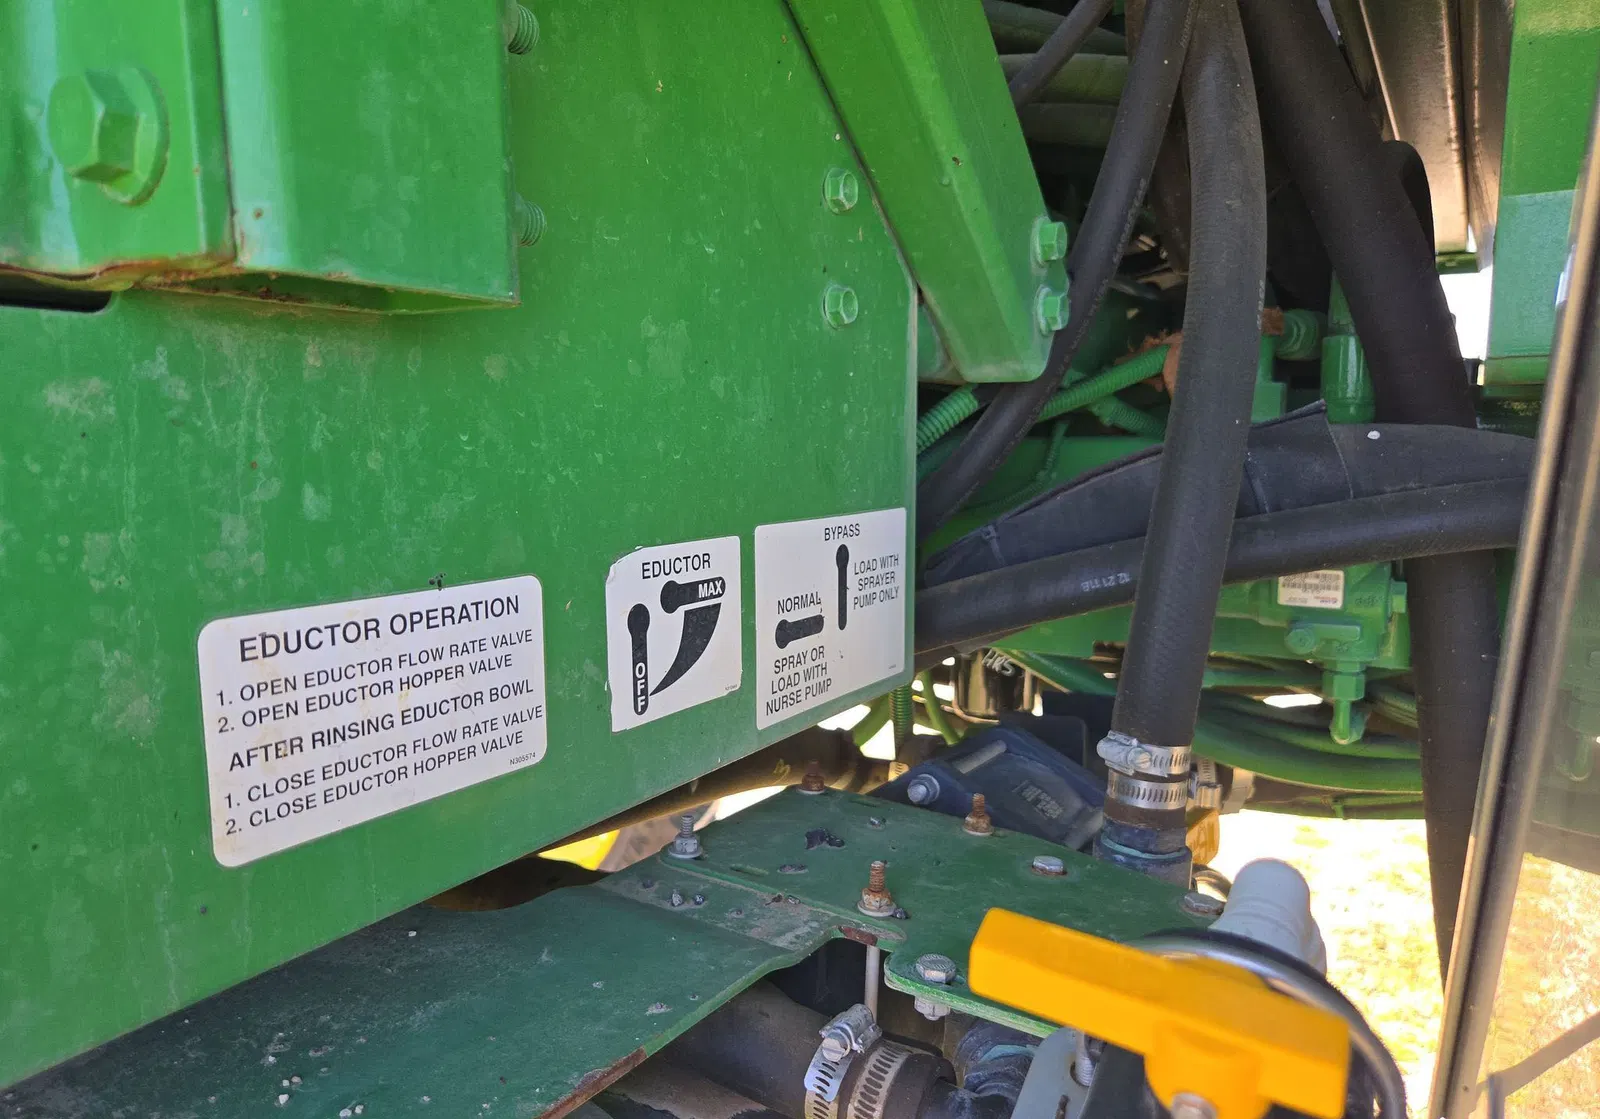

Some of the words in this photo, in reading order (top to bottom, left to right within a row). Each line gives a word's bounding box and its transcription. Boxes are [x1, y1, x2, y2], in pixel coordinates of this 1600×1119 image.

[824, 524, 860, 541] BYPASS
[642, 553, 711, 579] EDUCTOR
[854, 559, 877, 575] LOAD
[880, 554, 899, 570] WITH
[699, 580, 722, 598] MAX
[853, 592, 877, 609] PUMP
[878, 586, 899, 605] ONLY
[858, 572, 896, 591] SPRAYER
[777, 592, 821, 614] NORMAL
[239, 618, 380, 662] EDUCTOR
[390, 595, 519, 635] OPERATION
[217, 690, 232, 706] 1.
[240, 676, 297, 701] OPEN
[304, 658, 392, 688] EDUCTOR
[398, 647, 444, 668] FLOW
[450, 638, 487, 658] RATE
[491, 629, 533, 648] VALVE
[774, 651, 808, 674] SPRAY
[811, 646, 825, 661] OR
[218, 717, 235, 733] 2.
[242, 701, 298, 727] OPEN
[306, 681, 393, 713] EDUCTOR
[400, 665, 464, 691] HOPPER
[469, 654, 512, 675] VALVE
[635, 663, 645, 712] OFF
[771, 671, 800, 694] LOAD
[803, 662, 827, 684] WITH
[766, 692, 801, 716] NURSE
[805, 678, 832, 702] PUMP
[229, 737, 303, 771] AFTER
[312, 714, 395, 749] RINSING
[401, 692, 484, 725] EDUCTOR
[490, 679, 533, 702] BOWL
[225, 793, 240, 809] 1.
[247, 770, 315, 802] CLOSE
[322, 744, 407, 780] EDUCTOR
[413, 730, 457, 753] FLOW
[462, 720, 499, 739] RATE
[502, 705, 543, 727] VALVE
[225, 819, 242, 835] 2.
[249, 796, 317, 827] CLOSE
[324, 767, 409, 803] EDUCTOR
[414, 746, 476, 775] HOPPER
[481, 731, 523, 754] VALVE
